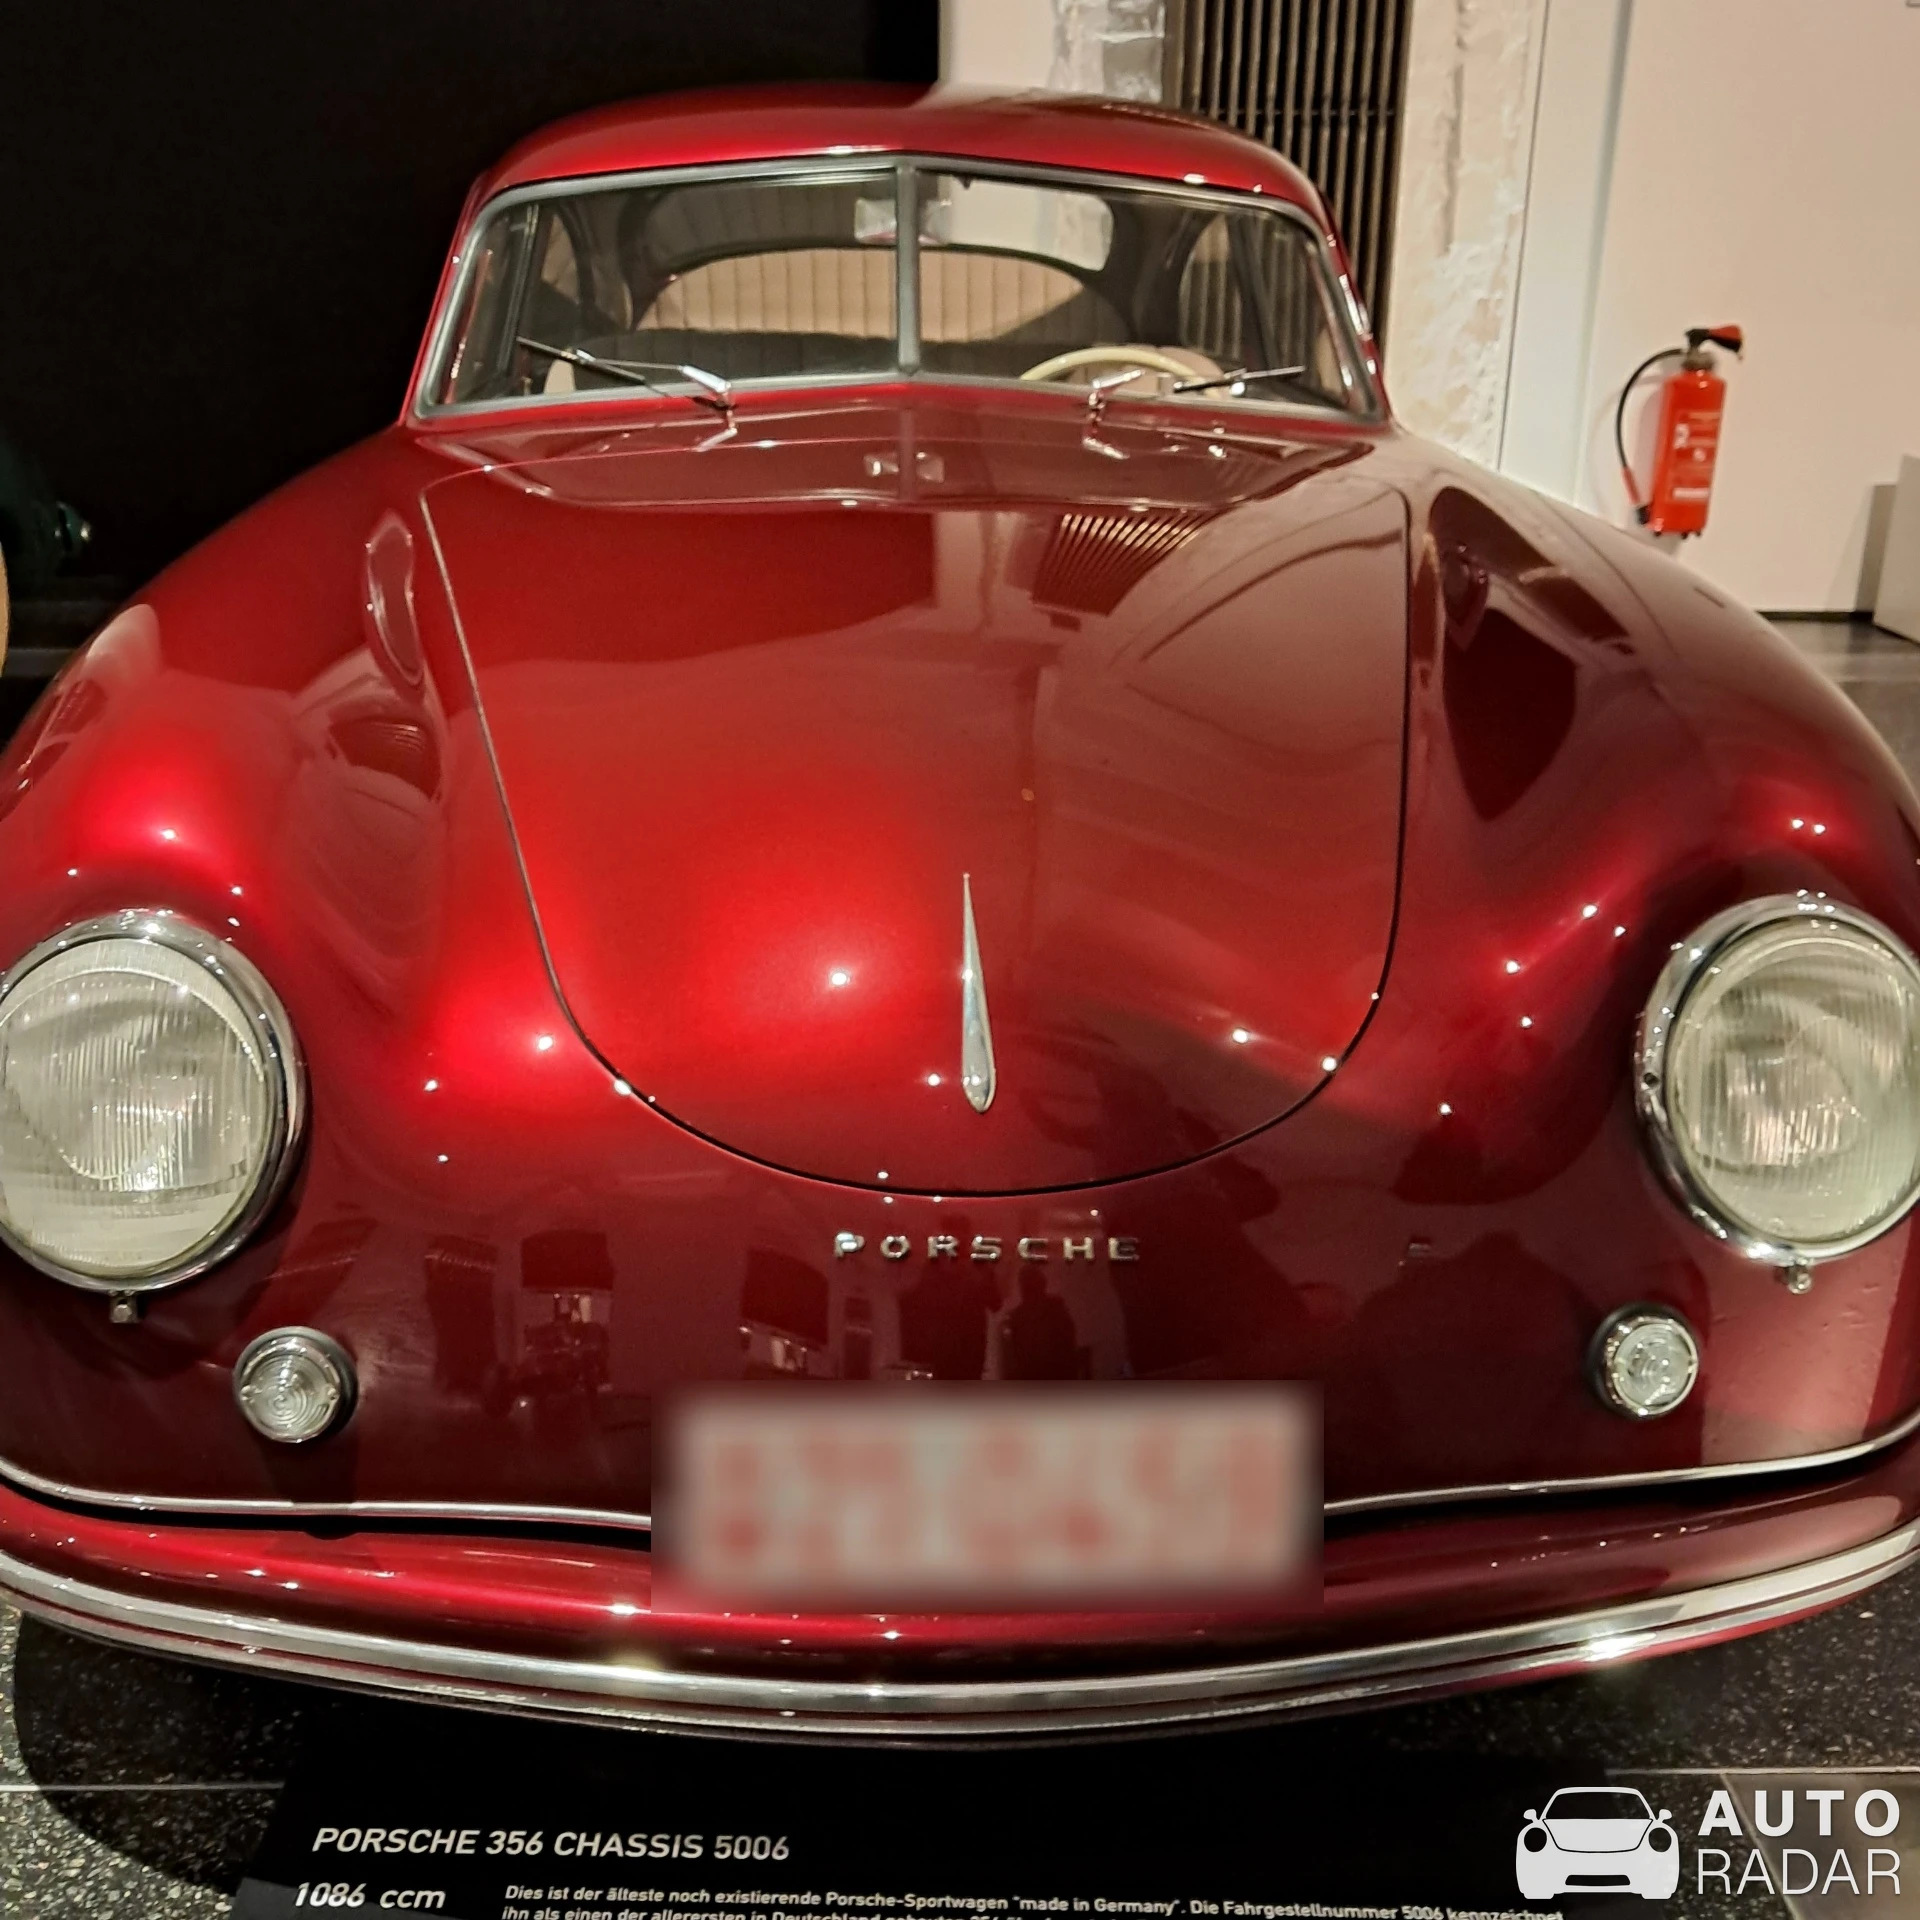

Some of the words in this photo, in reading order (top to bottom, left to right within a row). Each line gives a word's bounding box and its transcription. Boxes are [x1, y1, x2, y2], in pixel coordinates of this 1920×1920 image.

[833, 1230, 1141, 1262] PORSCHE
[312, 1828, 478, 1854] PORSCHE
[485, 1830, 544, 1855] 356
[553, 1832, 704, 1859] CHASSIS
[713, 1835, 790, 1861] 5006
[294, 1882, 367, 1908] 1086
[379, 1888, 446, 1909] ccm
[505, 1885, 543, 1900] Dies
[547, 1886, 570, 1901] ist
[573, 1887, 604, 1902] der
[606, 1887, 665, 1903] älteste
[668, 1889, 711, 1904] noch
[714, 1890, 822, 1906] existierende
[825, 1891, 1009, 1913] Porsche-Sportwagen
[1072, 1898, 1090, 1913] in
[1189, 1900, 1220, 1916] Die
[1223, 1901, 1399, 1920] Fahrgestellnummer
[1401, 1905, 1444, 1920] 5006
[501, 1906, 530, 1920] ihn
[533, 1907, 561, 1920] als
[565, 1907, 613, 1920] einen
[617, 1908, 648, 1920] der
